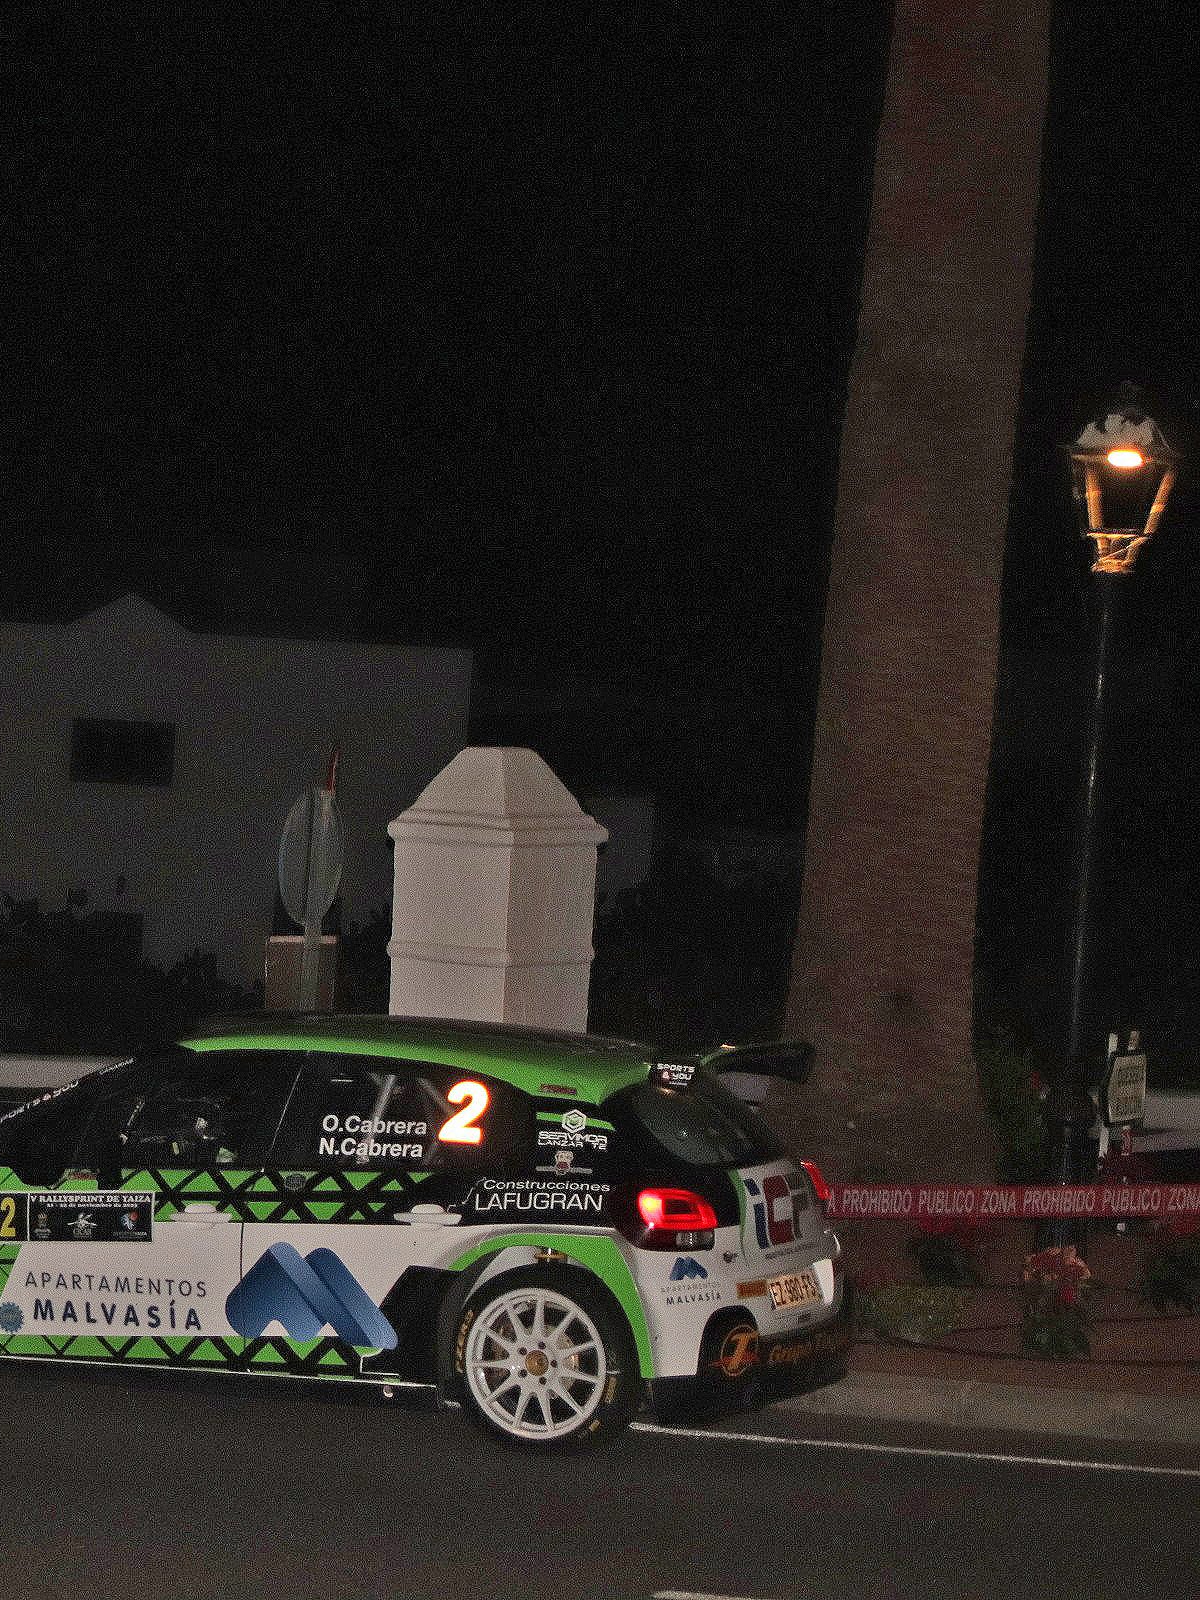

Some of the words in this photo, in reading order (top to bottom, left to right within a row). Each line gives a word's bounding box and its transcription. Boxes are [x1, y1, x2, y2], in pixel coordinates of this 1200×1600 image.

[438, 1080, 491, 1144] 2
[322, 1114, 427, 1135] O.Cabrera
[319, 1137, 423, 1158] N.Cabrera
[483, 1179, 611, 1192] Construcciones
[39, 1195, 105, 1203] RALLYSPRINT
[106, 1195, 121, 1203] DE
[122, 1195, 150, 1203] YAIZA
[475, 1192, 603, 1211] LAFUGRAN
[842, 1189, 912, 1213] PROHIBIDO
[918, 1189, 976, 1213] PUBLICO
[981, 1189, 1016, 1213] ZONA
[1023, 1189, 1095, 1212] PROHIBIDO
[1102, 1188, 1161, 1212] PUBLICO
[0, 1197, 16, 1237] 2
[25, 1271, 207, 1298] APARTAMENTOS
[33, 1298, 201, 1331] MALVASÍA
